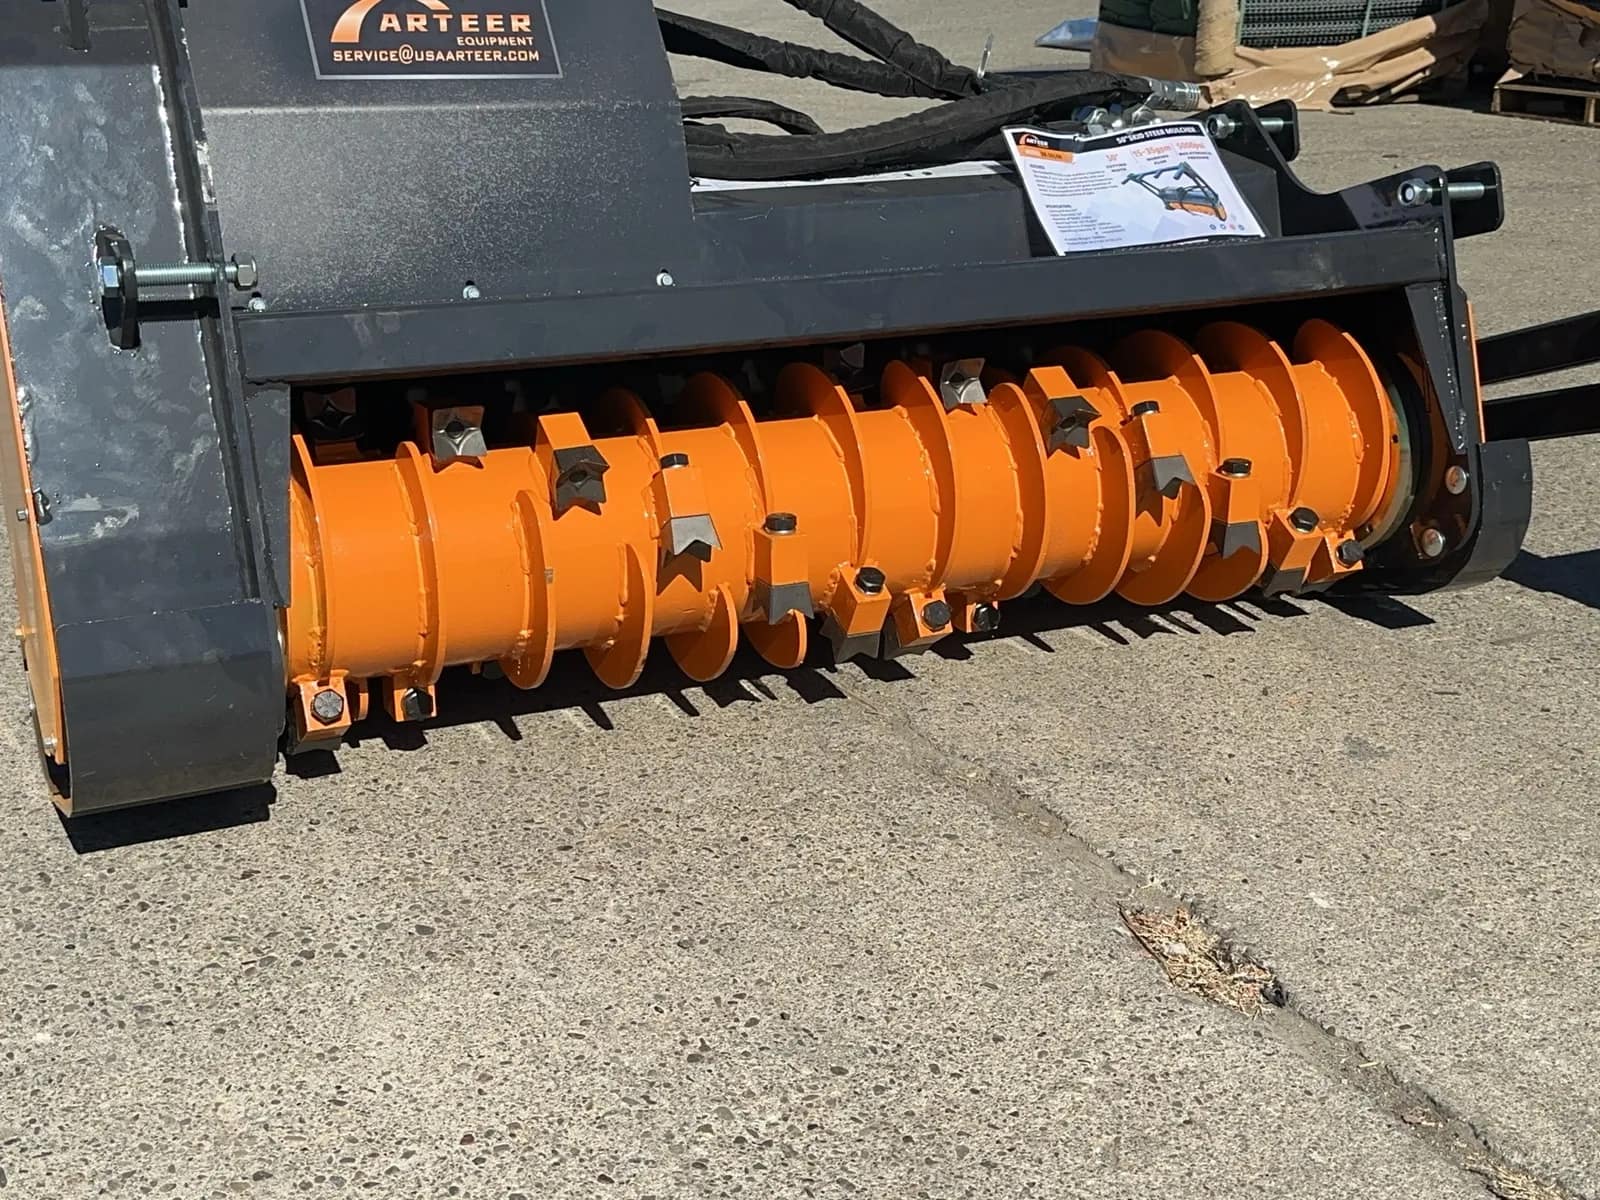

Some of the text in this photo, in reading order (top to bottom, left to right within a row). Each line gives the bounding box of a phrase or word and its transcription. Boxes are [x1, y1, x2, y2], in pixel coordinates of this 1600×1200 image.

[379, 13, 532, 33] ARTEER
[456, 36, 534, 46] EQUIPMENT
[333, 44, 540, 64] SERVICE@USAARTEER.COM
